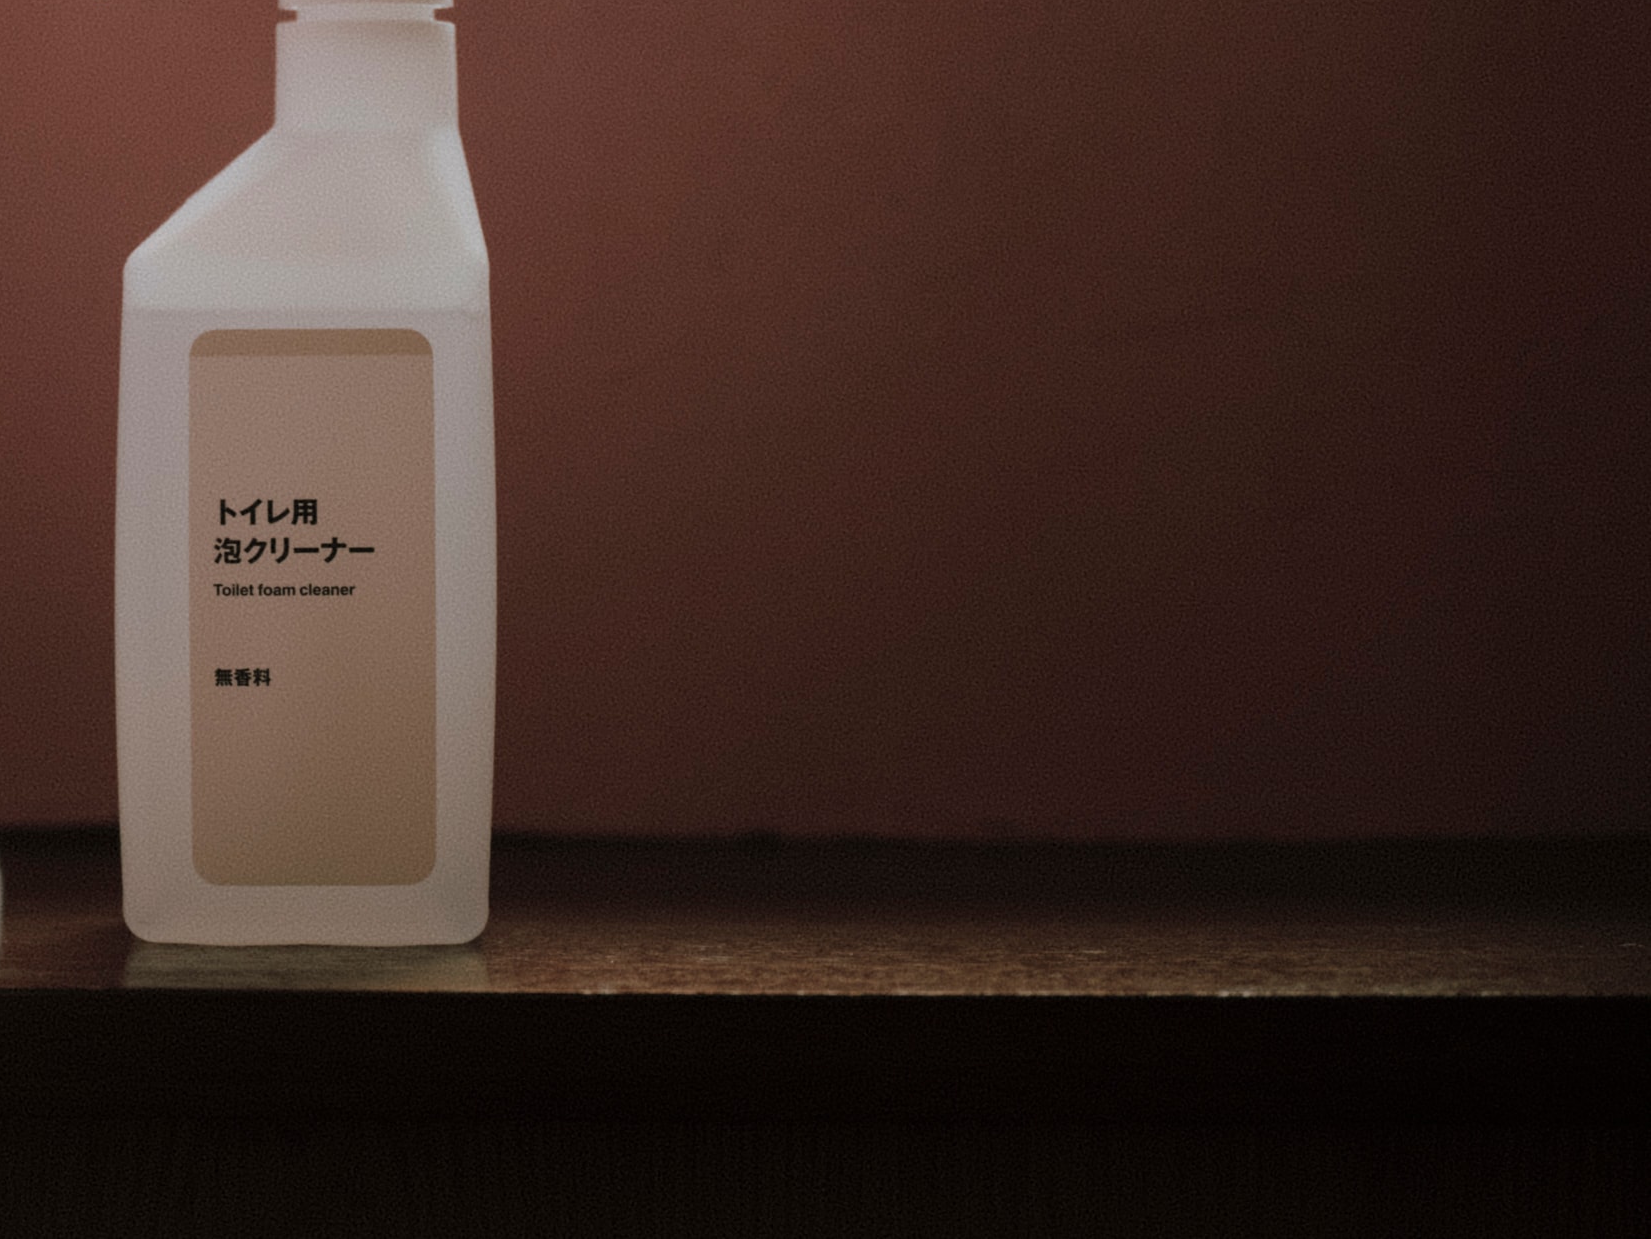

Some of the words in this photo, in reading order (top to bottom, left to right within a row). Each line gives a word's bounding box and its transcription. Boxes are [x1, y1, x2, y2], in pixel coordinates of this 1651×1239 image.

[220, 499, 318, 525] トイレ用
[214, 537, 375, 564] 泡クリーナー
[213, 583, 254, 596] Toilet
[258, 583, 296, 596] foam
[299, 583, 356, 596] cleaner
[214, 668, 271, 686] 無香料
